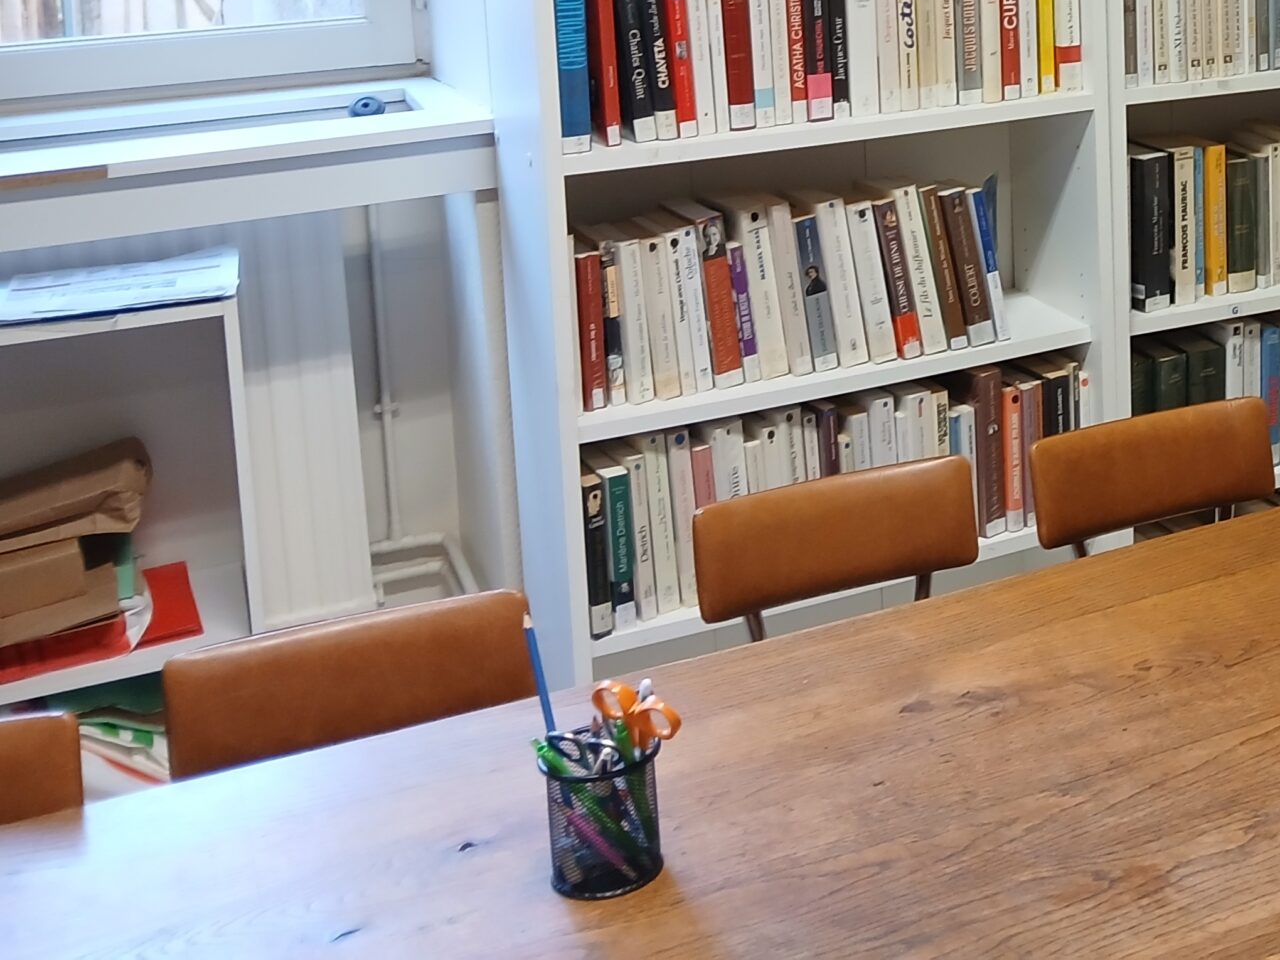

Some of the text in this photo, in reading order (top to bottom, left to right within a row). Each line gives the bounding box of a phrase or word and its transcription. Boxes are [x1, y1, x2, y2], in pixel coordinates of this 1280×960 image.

[628, 29, 645, 98] Charles Quint
[792, 42, 805, 88] AGATHA
[963, 26, 977, 72] JACQUES
[890, 241, 901, 262] DINO
[965, 263, 981, 306] COLBERT
[616, 502, 628, 572] Marlène Dietrich
[639, 525, 649, 563] Dietrich
